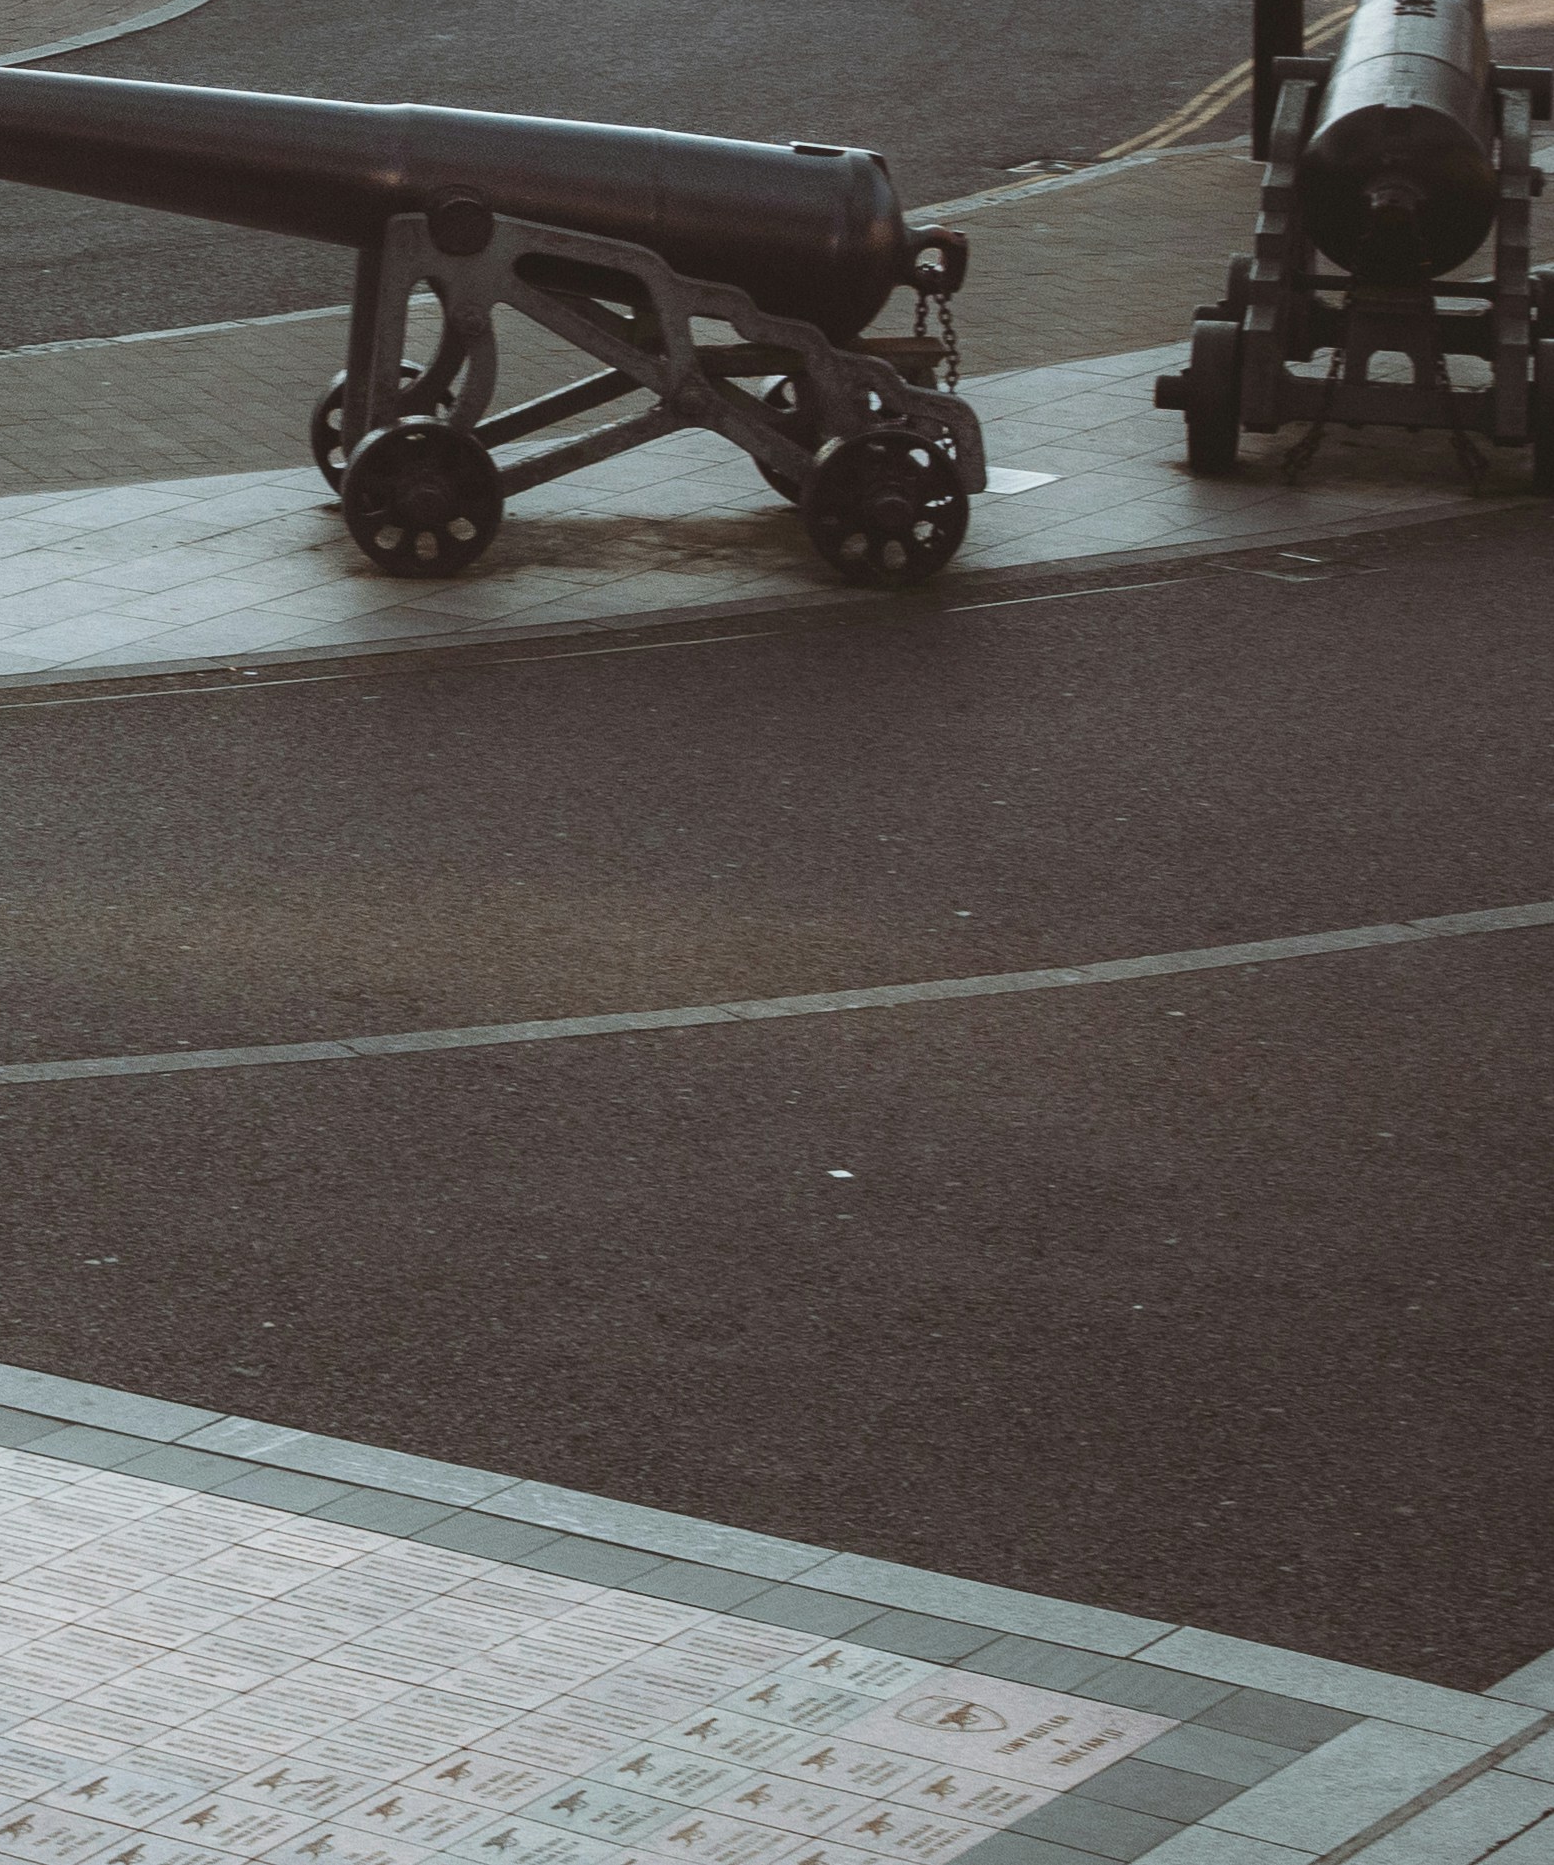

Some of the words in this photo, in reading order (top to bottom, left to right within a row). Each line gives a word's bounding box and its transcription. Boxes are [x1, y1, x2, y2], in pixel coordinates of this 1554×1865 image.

[994, 1737, 1032, 1755] TONY
[1023, 1715, 1074, 1739] BUTLER
[1051, 1749, 1089, 1766] TRUE
[1078, 1737, 1110, 1751] FAN
